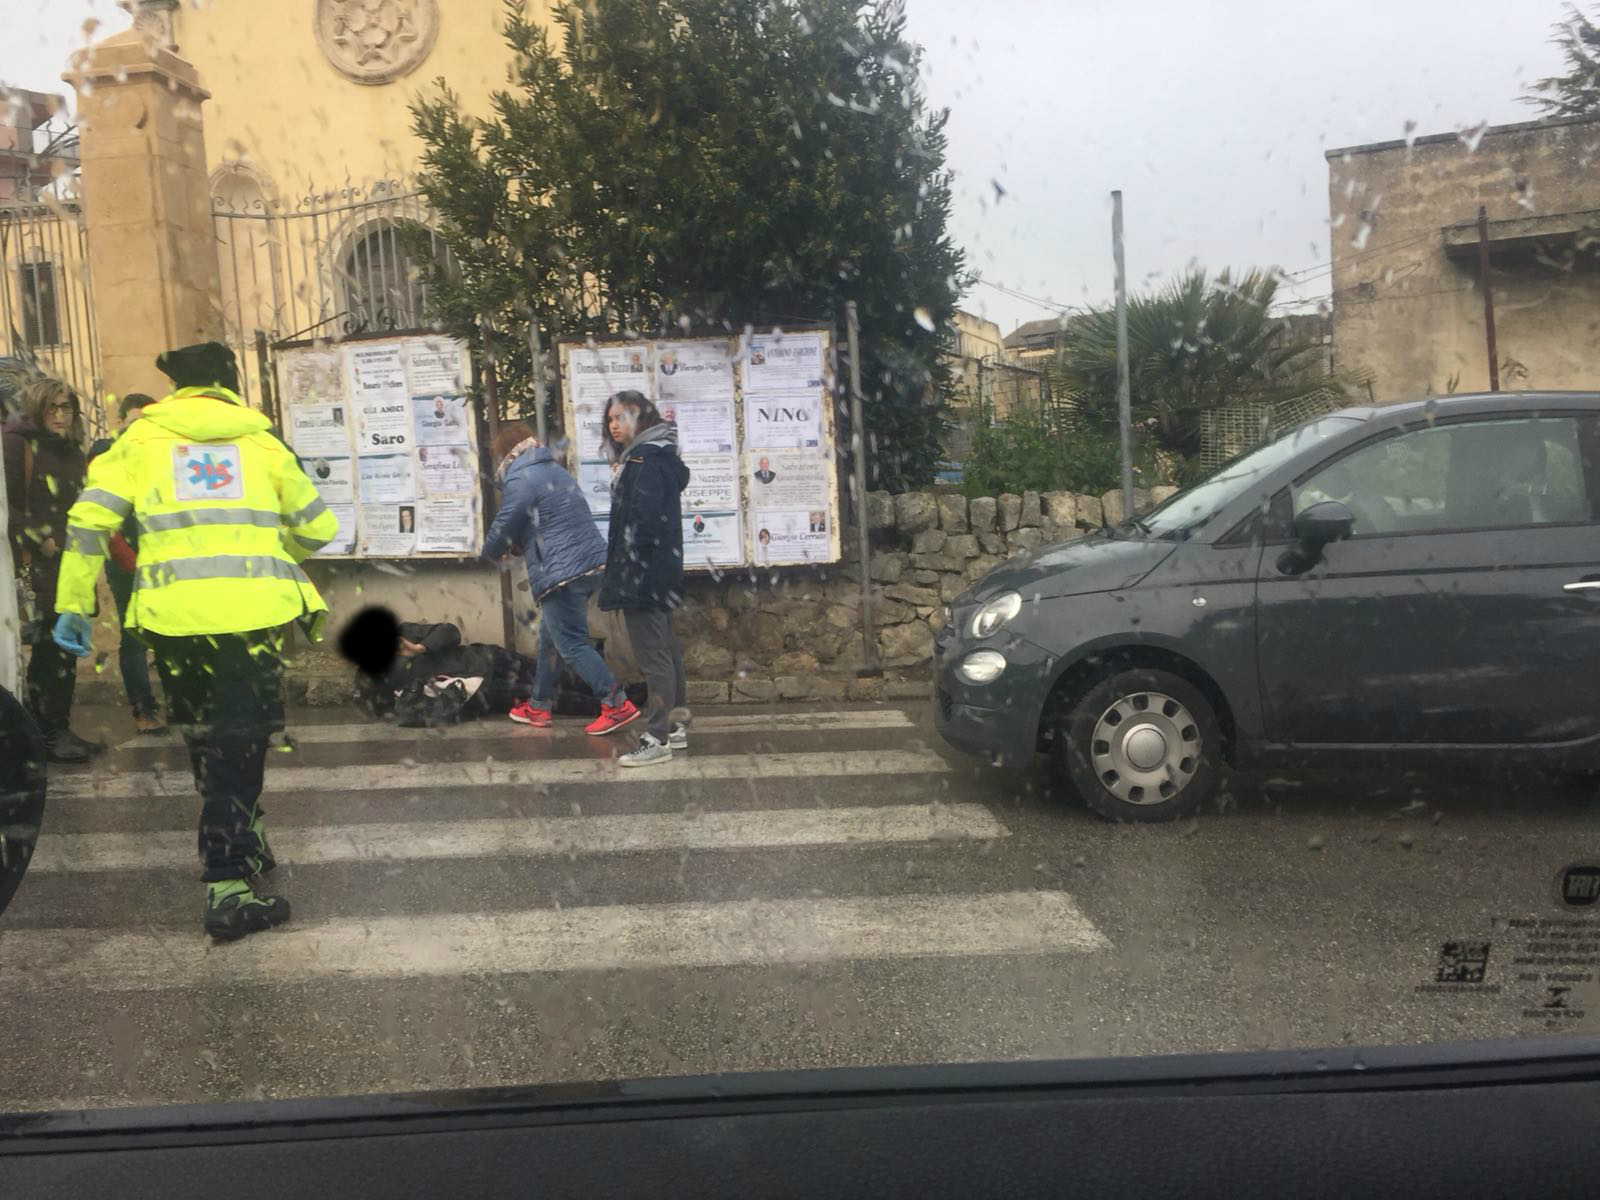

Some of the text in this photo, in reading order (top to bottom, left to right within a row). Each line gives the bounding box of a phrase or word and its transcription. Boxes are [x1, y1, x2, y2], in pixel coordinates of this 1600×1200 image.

[380, 405, 404, 413] AMICI
[756, 407, 809, 423] NINO
[371, 433, 405, 446] Saro
